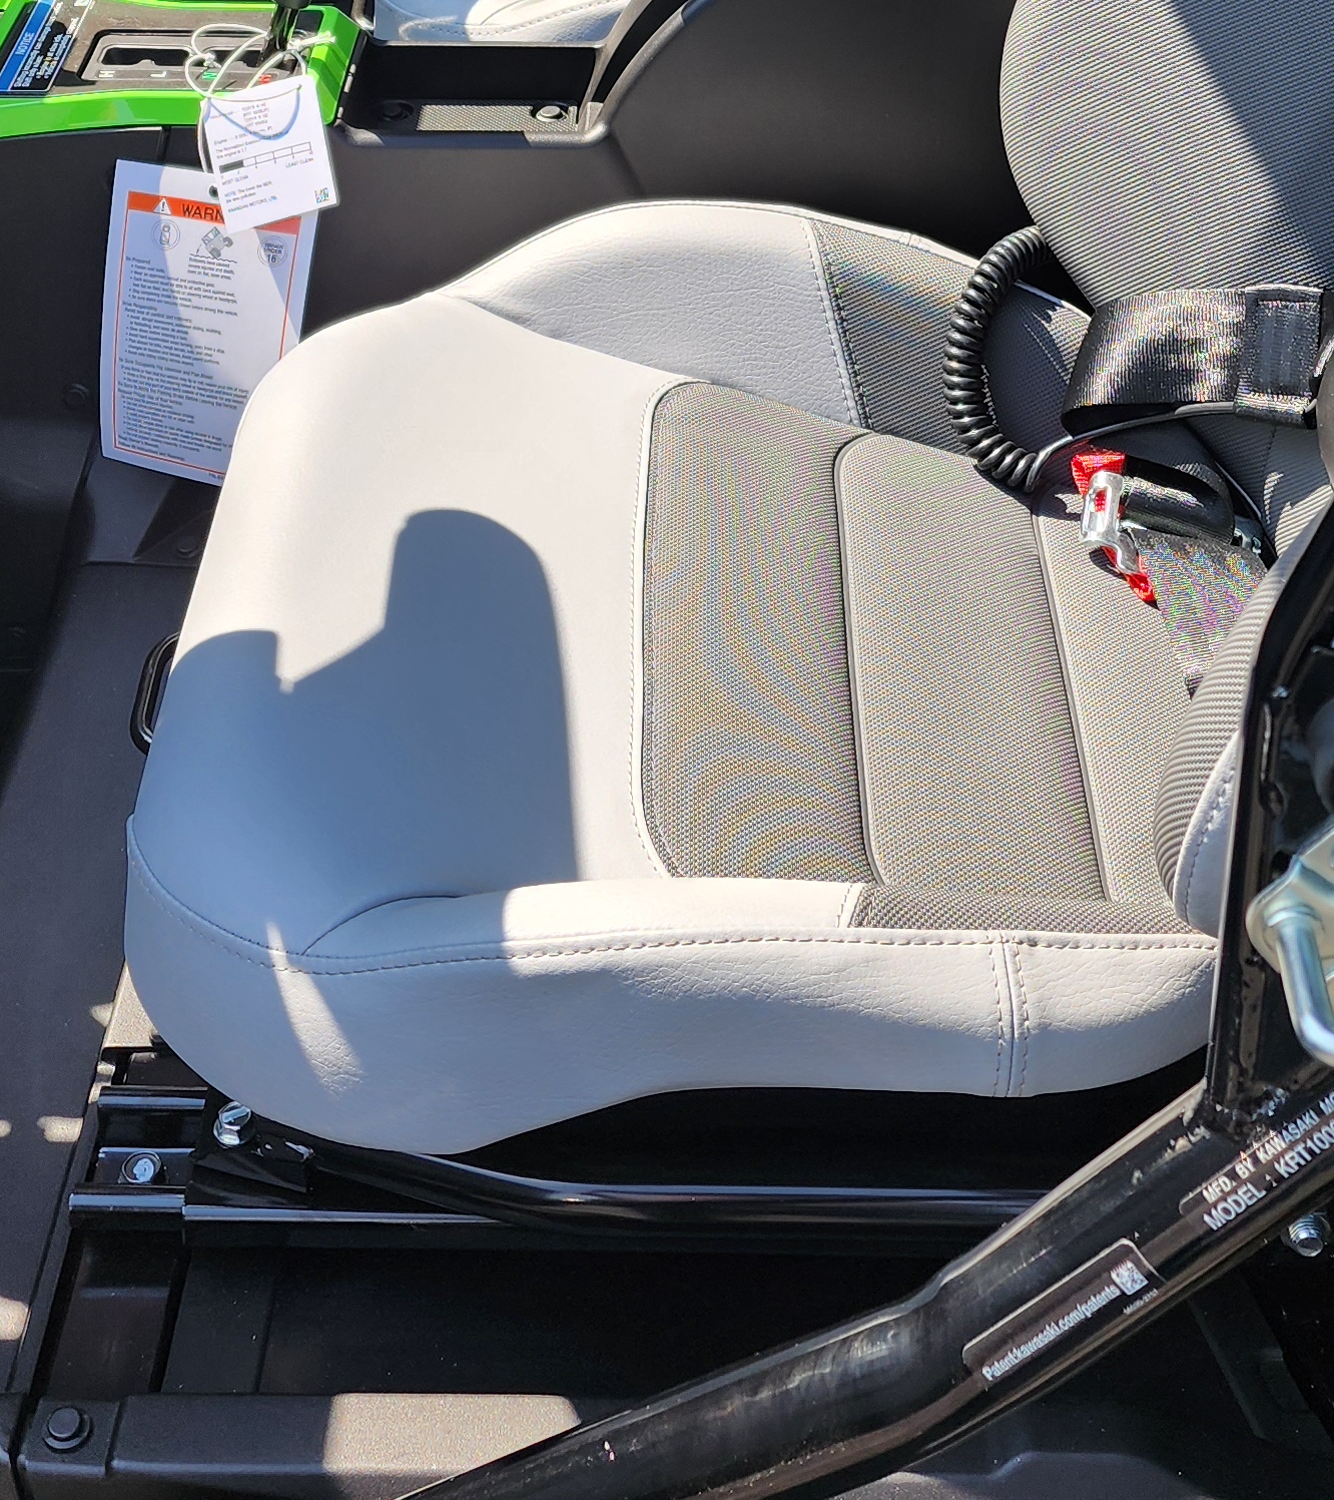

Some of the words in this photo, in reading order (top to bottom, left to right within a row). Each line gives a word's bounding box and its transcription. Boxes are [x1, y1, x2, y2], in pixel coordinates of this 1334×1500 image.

[16, 32, 35, 56] NOTICE
[182, 204, 224, 223] WARN
[1234, 1154, 1256, 1180] BY
[1255, 1107, 1322, 1164] KAWASAKI
[1202, 1182, 1268, 1232] MODEL
